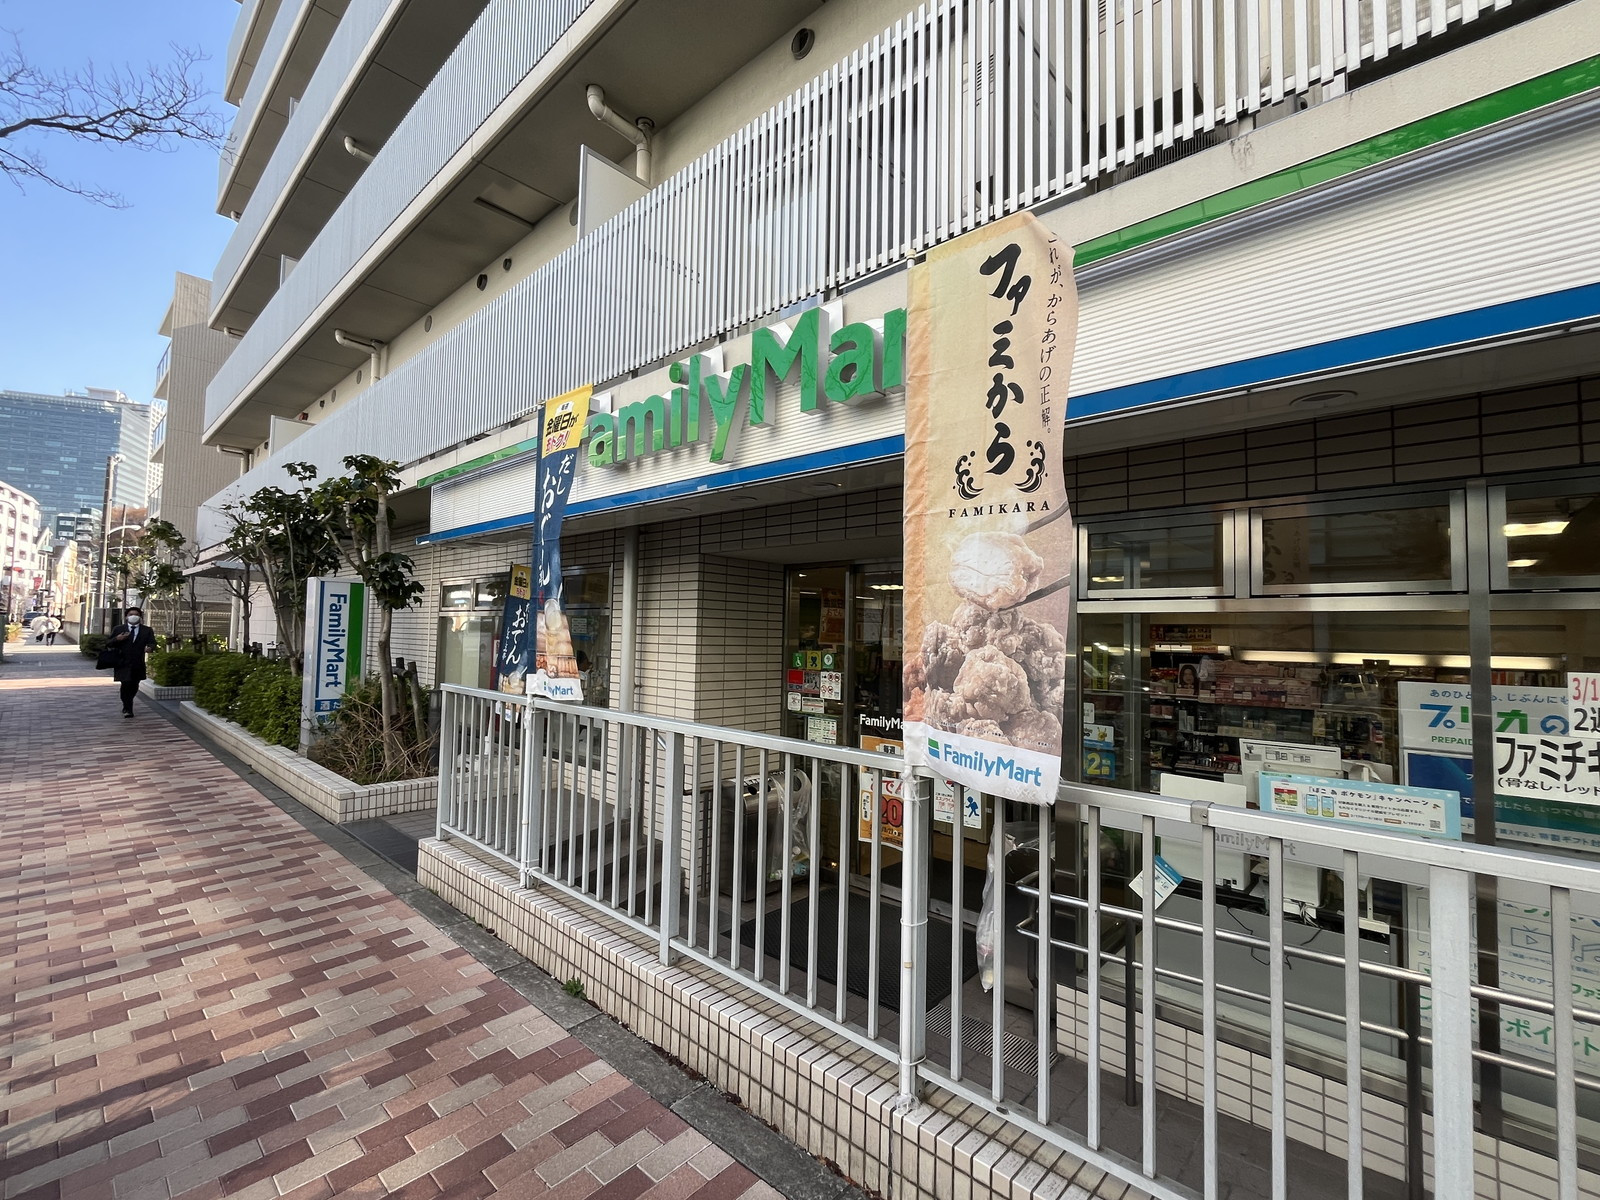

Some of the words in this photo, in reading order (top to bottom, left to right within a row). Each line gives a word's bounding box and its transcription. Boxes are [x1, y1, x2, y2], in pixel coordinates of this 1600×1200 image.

[980, 243, 1032, 475] ファミから
[1039, 231, 1063, 434] これが、からあげの正解。
[580, 306, 907, 468] amilyMar
[949, 500, 1051, 518] FAMIKARA
[323, 593, 347, 687] FamilyMart
[506, 604, 527, 665] おでん
[943, 743, 1042, 787] FamilyMart
